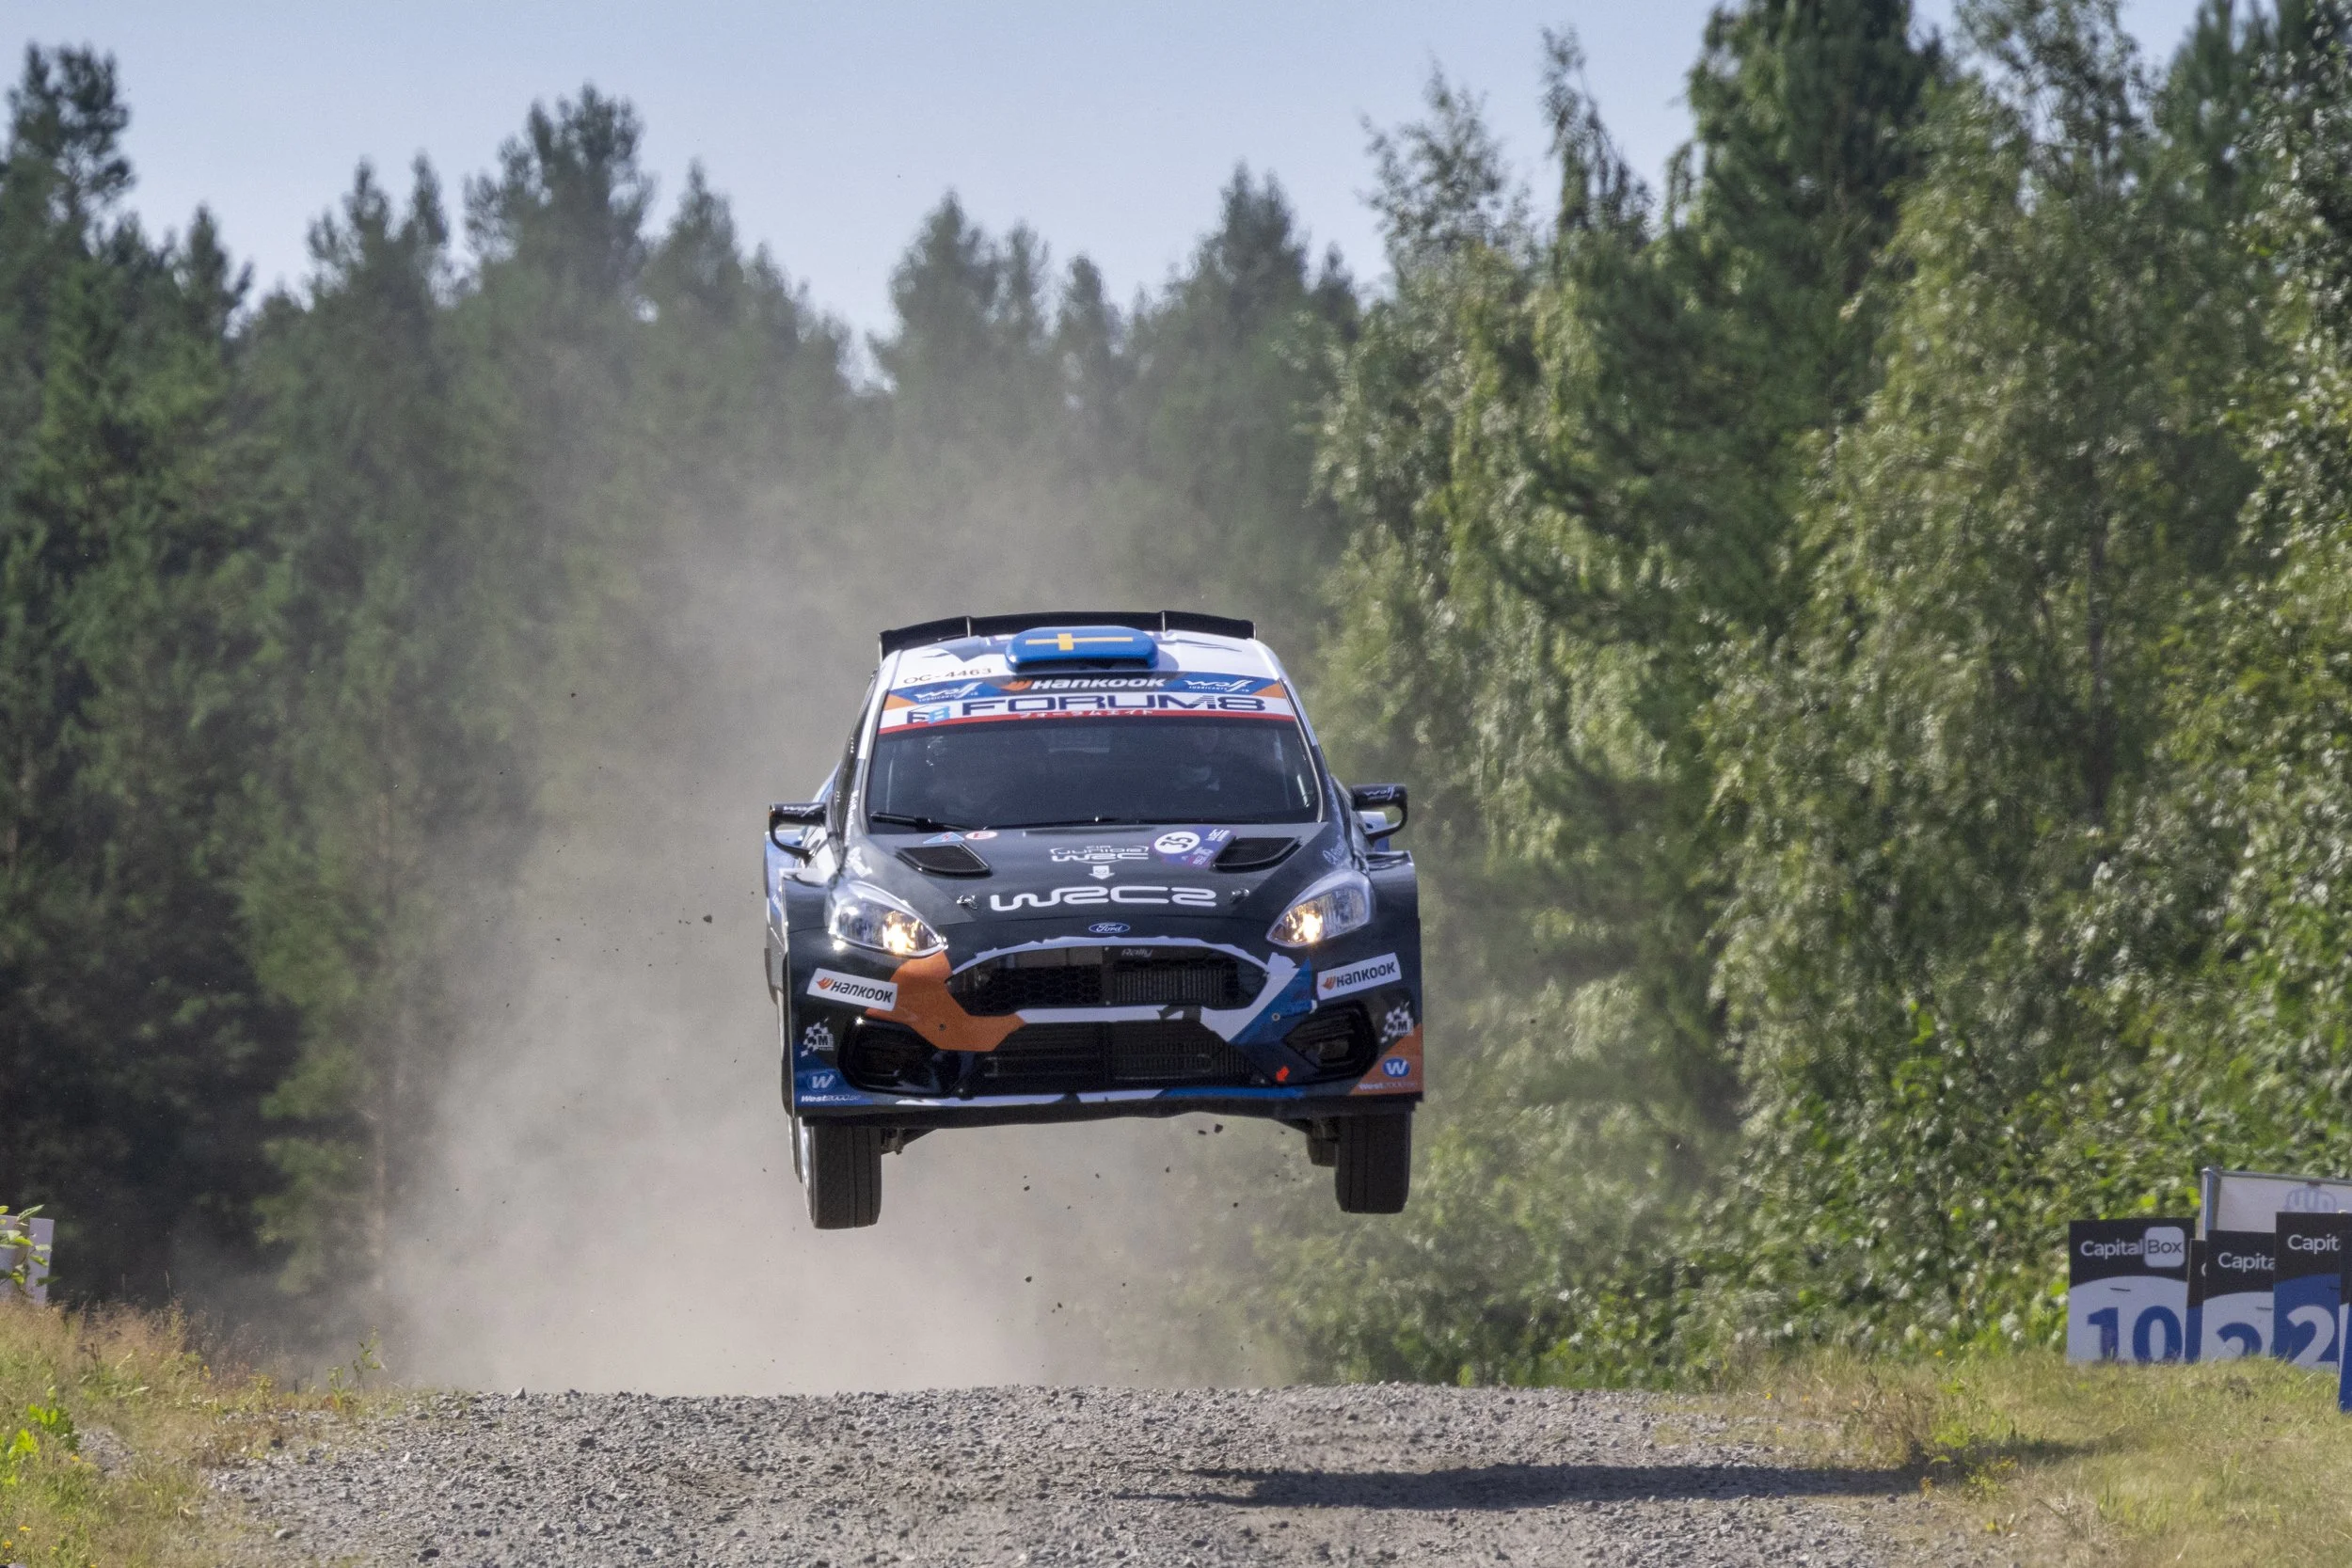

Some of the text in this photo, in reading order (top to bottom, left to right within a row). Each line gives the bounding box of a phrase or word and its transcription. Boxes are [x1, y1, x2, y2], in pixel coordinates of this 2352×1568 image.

[903, 668, 993, 685] OC-4463
[961, 694, 1266, 716] FORUM8
[1160, 836, 1193, 848] 35
[1052, 852, 1150, 863] WRC
[990, 886, 1217, 911] WRC2
[1096, 924, 1123, 932] Ford
[1121, 948, 1153, 958] Rally
[1385, 1060, 1408, 1076] W
[811, 1074, 835, 1089] W
[2287, 1234, 2340, 1254] Capit
[2087, 1306, 2183, 1363] 10
